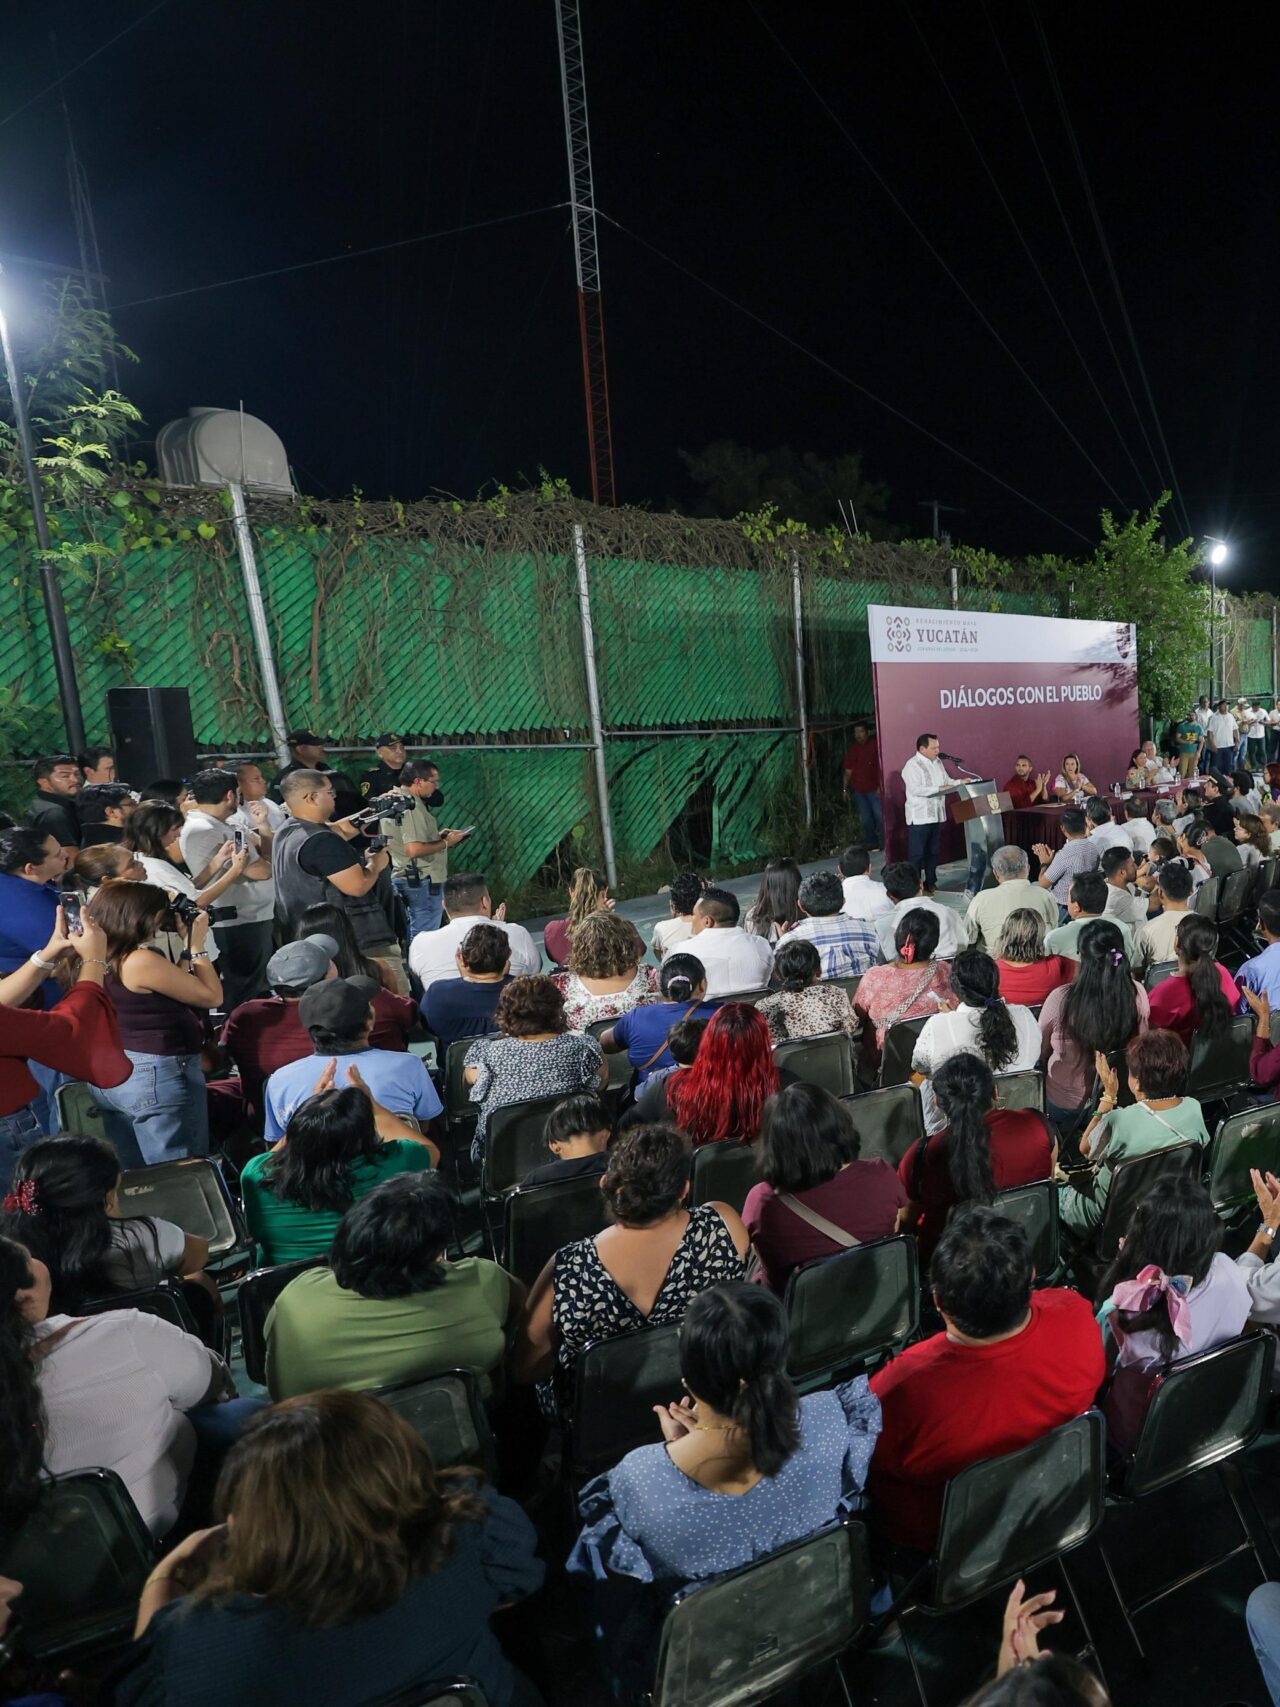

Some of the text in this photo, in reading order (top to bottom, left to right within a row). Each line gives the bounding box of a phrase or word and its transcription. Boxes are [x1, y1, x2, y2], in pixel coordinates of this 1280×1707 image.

[916, 628, 978, 644] YUCATÁN
[940, 684, 1102, 709] DIÁLOGOS CON EL PUEBLO
